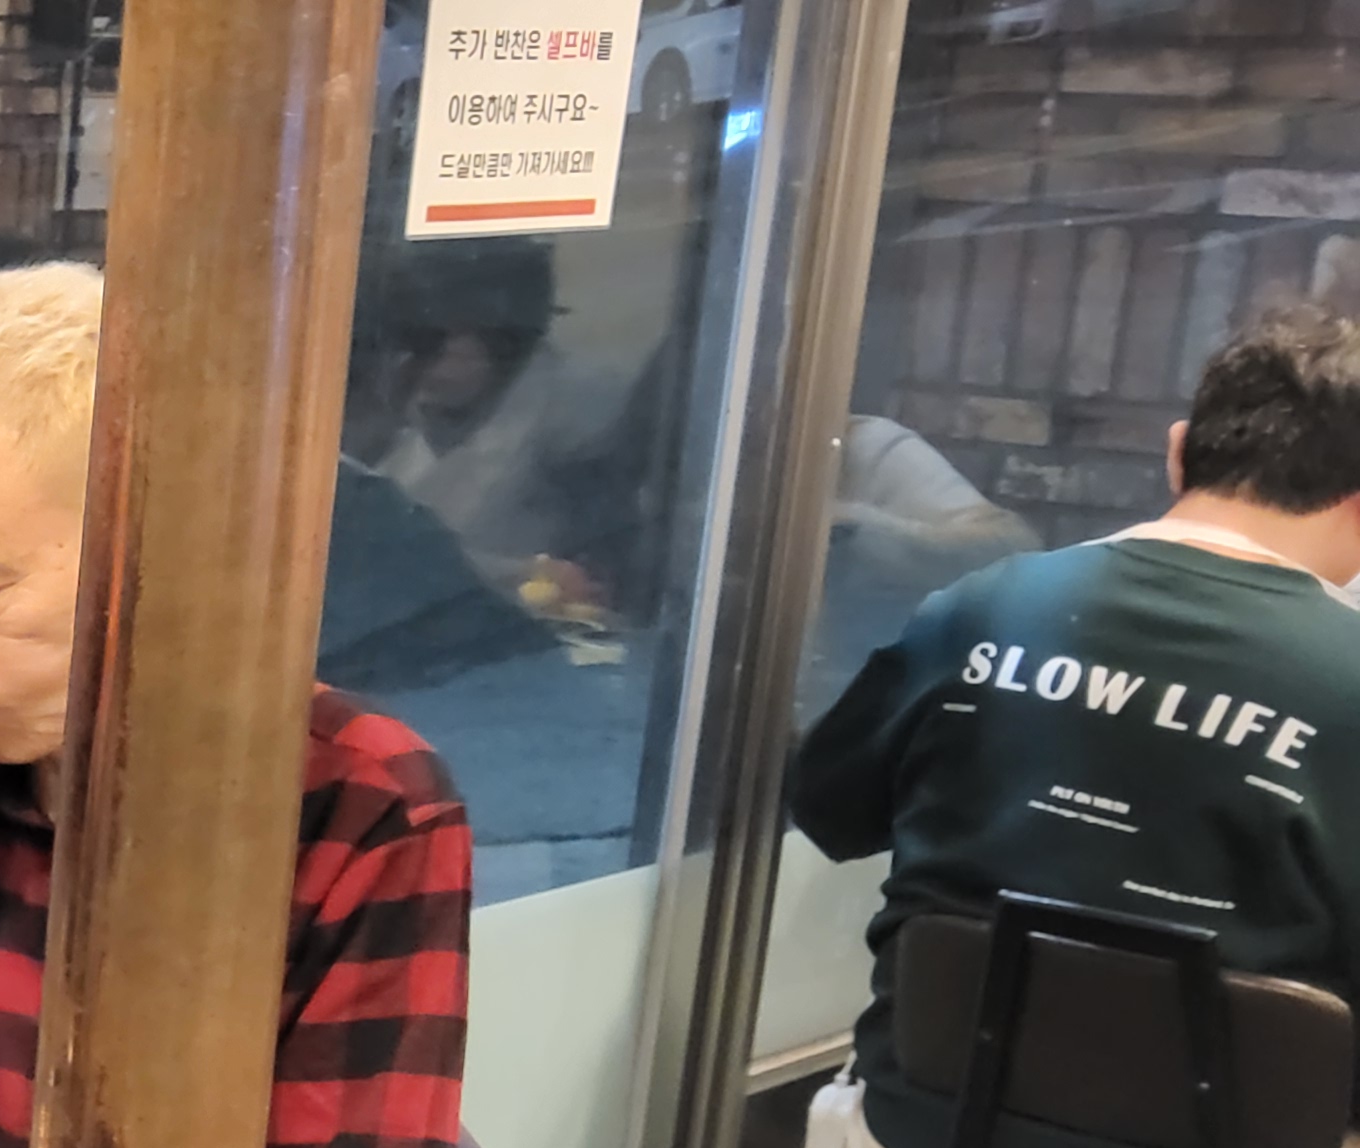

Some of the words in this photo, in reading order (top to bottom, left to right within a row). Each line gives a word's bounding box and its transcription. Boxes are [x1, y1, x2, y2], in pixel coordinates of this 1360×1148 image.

[448, 29, 487, 61] 추가
[494, 29, 541, 61] 반찬은
[546, 29, 614, 62] 셀프바를
[448, 94, 518, 125] 이용하여
[523, 92, 600, 125] 주시구요~
[438, 152, 513, 179] 드실만큼만
[961, 641, 1146, 715] SLOW
[1154, 683, 1318, 769] LIFE
